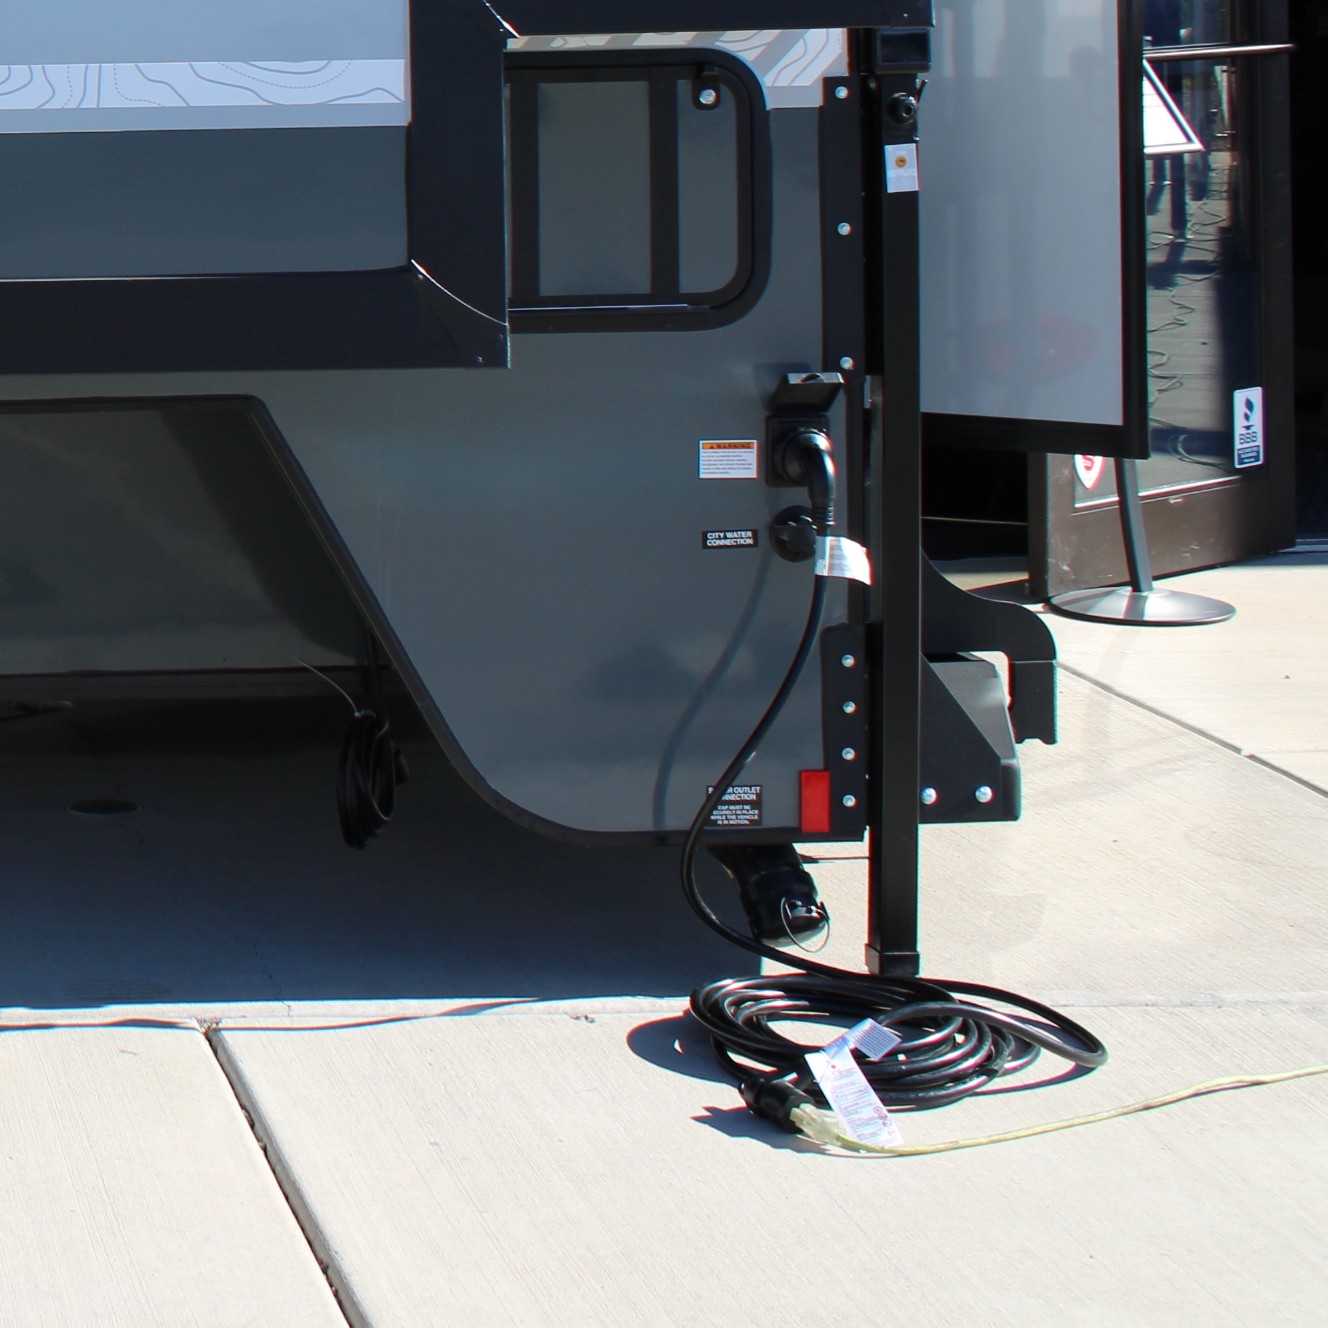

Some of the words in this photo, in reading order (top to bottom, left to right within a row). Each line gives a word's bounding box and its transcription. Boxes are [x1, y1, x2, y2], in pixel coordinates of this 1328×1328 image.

[1239, 431, 1258, 445] BBB
[725, 531, 753, 539] WATER
[706, 538, 754, 546] CONNECTION
[734, 786, 761, 794] OUTLET
